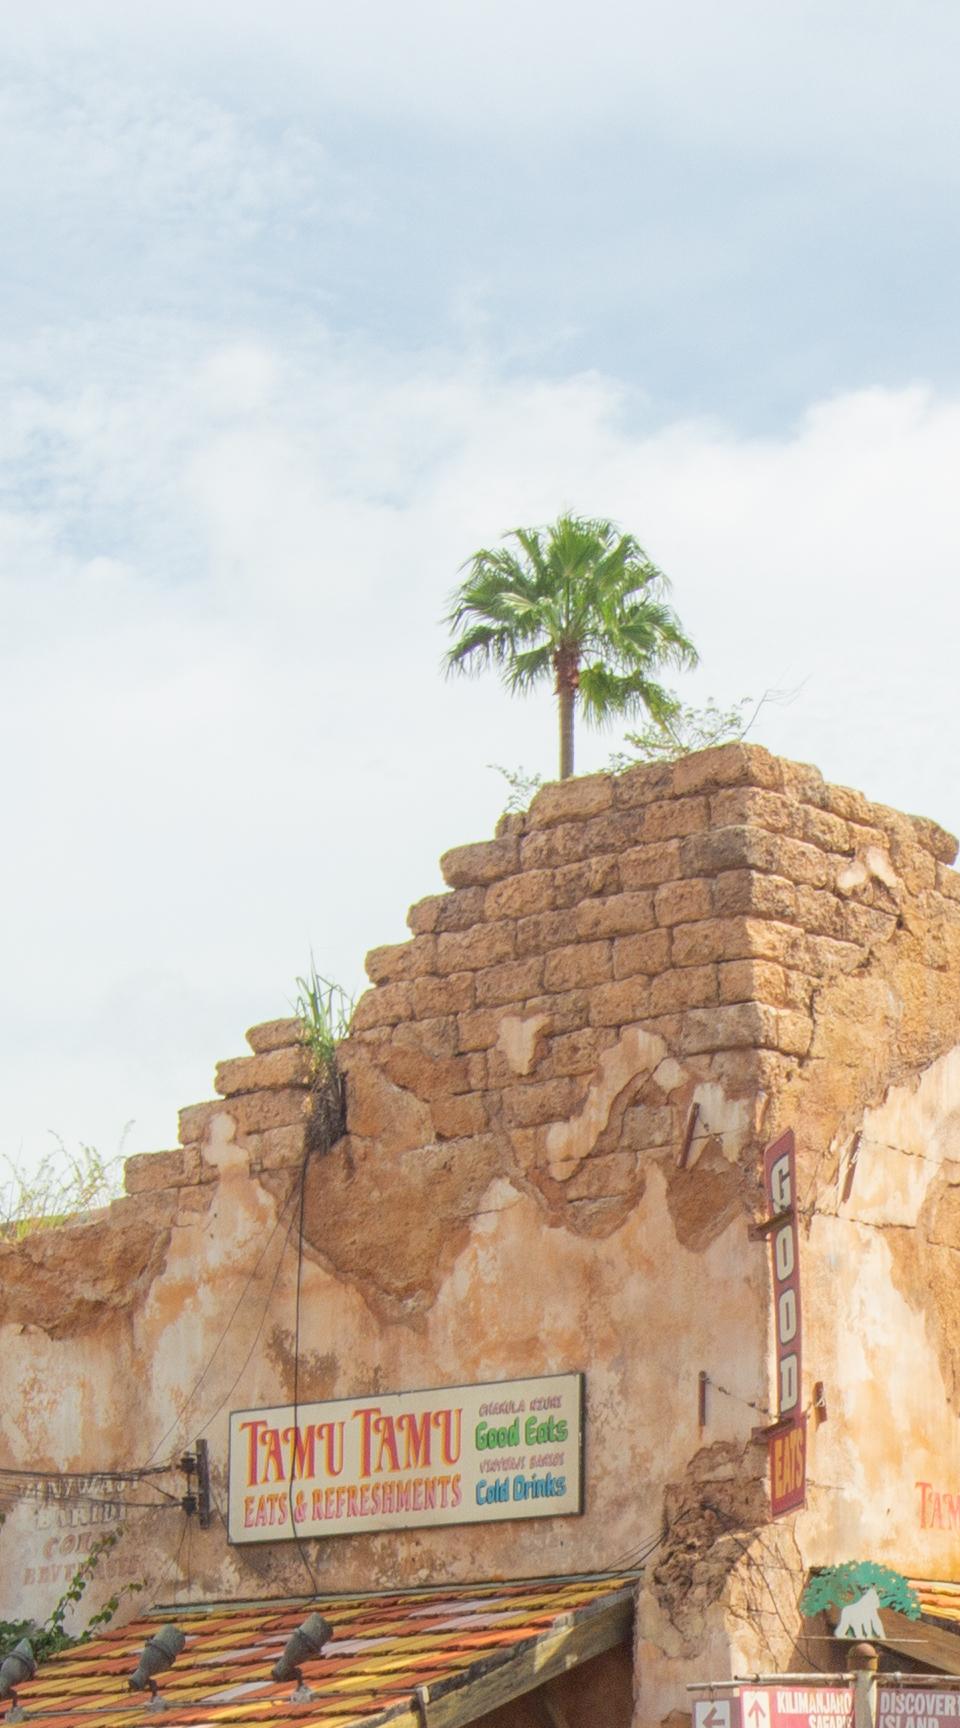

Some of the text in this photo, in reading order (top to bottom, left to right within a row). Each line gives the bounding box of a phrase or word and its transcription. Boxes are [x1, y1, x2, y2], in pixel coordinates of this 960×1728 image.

[771, 1154, 798, 1413] GOOD
[239, 1407, 463, 1488] TAMU TAMU
[475, 1414, 569, 1451] Good Eats
[475, 1472, 567, 1505] Cold Drinks
[774, 1427, 804, 1499] EATS
[244, 1472, 463, 1528] EATS & REFRESHMENTS
[777, 1691, 852, 1715] KILIMANJARO
